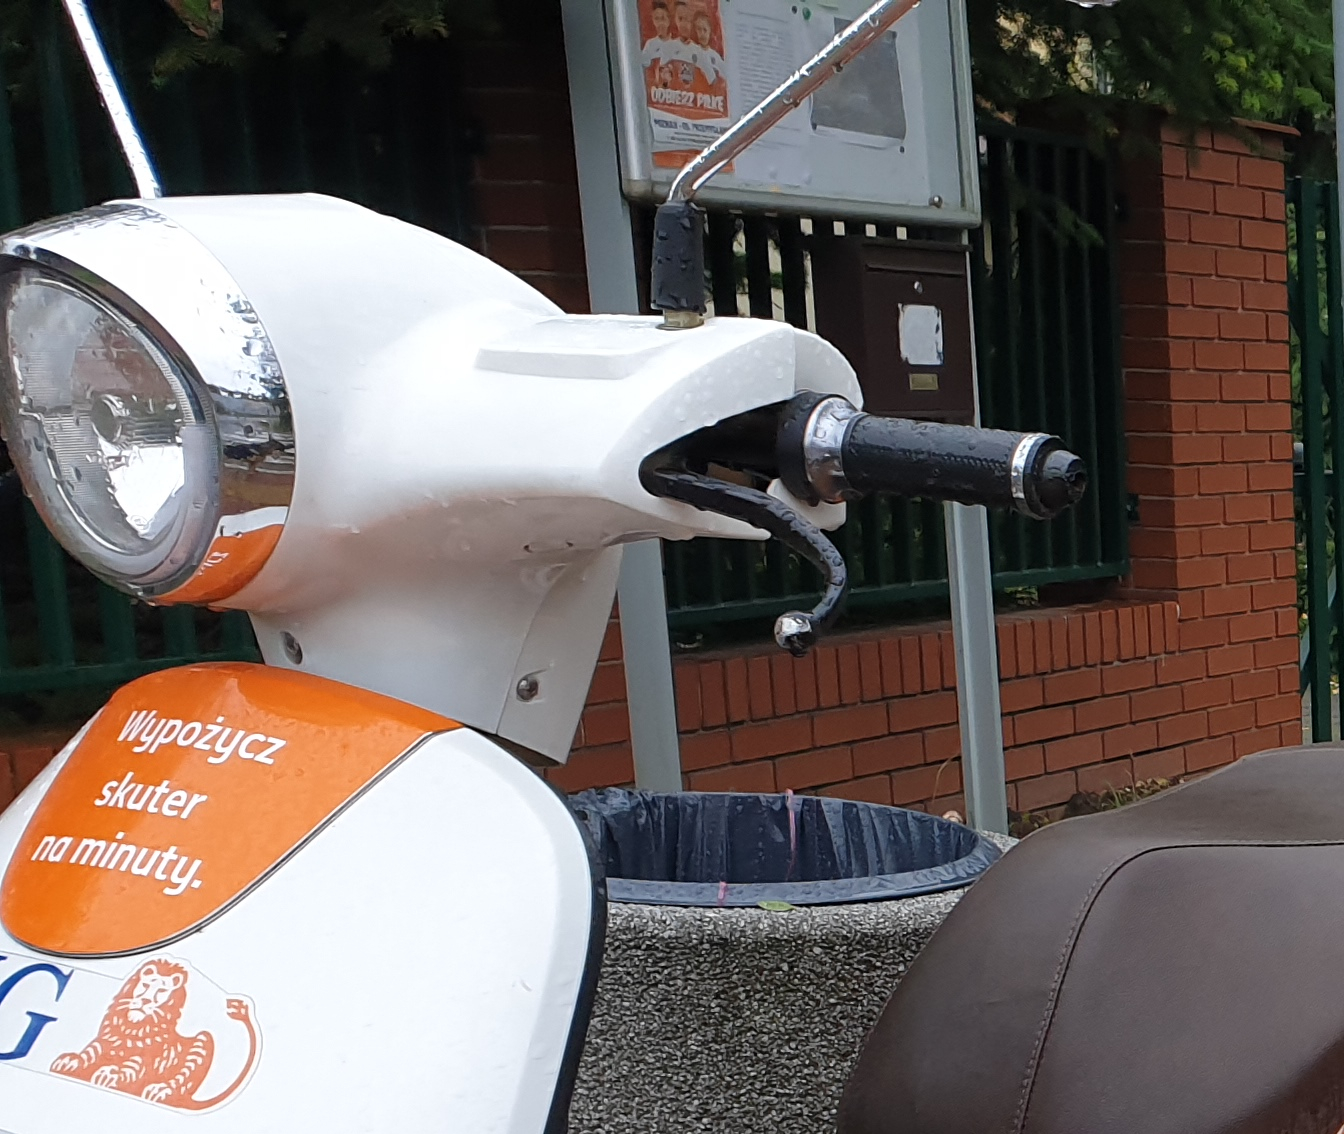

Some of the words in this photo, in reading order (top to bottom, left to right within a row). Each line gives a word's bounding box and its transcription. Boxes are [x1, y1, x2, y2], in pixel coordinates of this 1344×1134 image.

[117, 709, 286, 765] Wypożycz
[94, 771, 208, 819] skuter
[30, 835, 73, 862] na
[69, 831, 202, 896] minuty.
